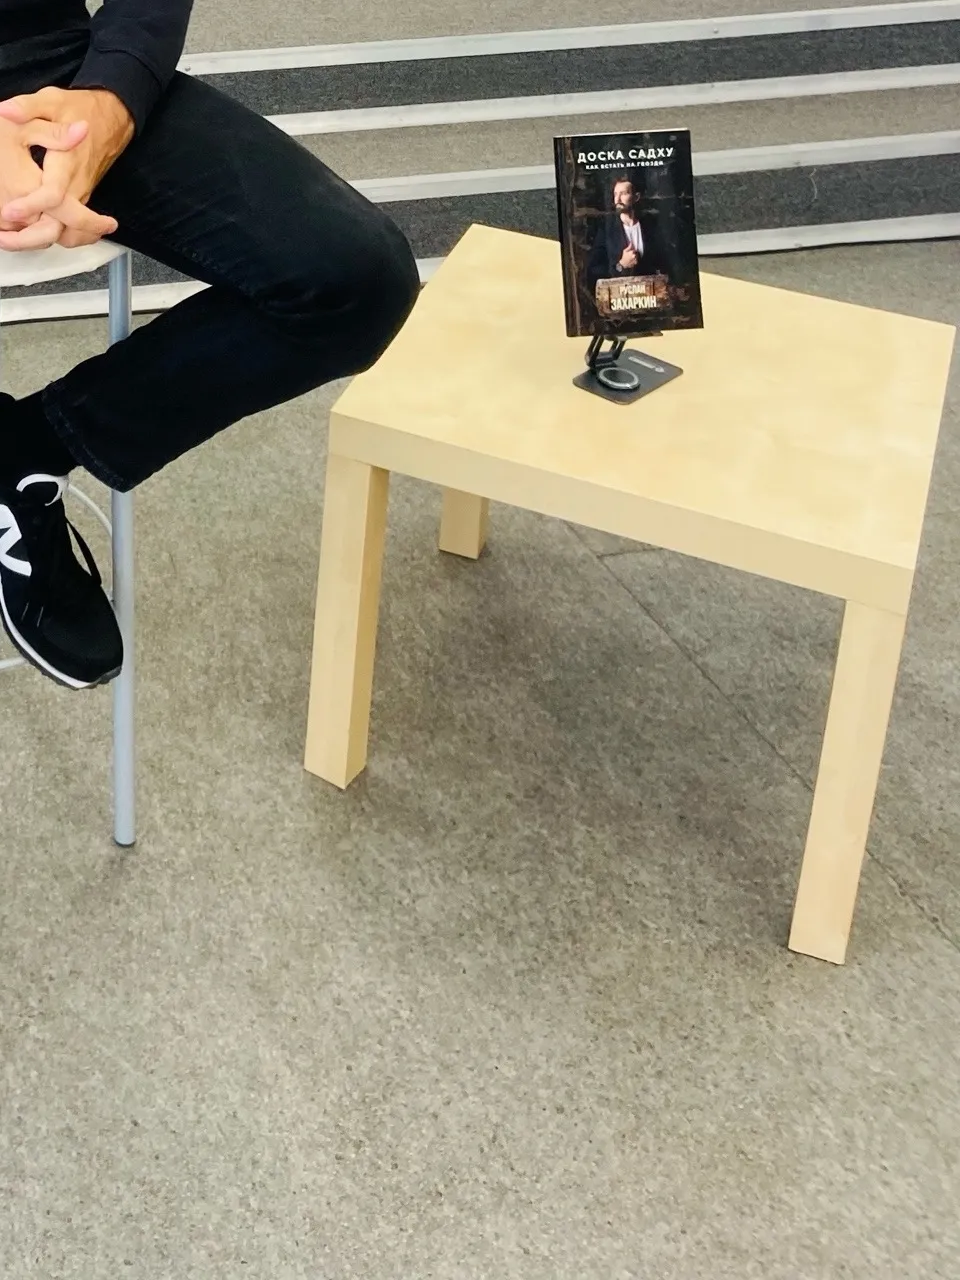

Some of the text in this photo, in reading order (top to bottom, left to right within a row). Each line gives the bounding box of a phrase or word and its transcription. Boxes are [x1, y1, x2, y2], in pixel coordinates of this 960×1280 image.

[577, 147, 674, 163] ДОСКА САДХУ
[611, 295, 657, 311] ЗАХАРКИН
